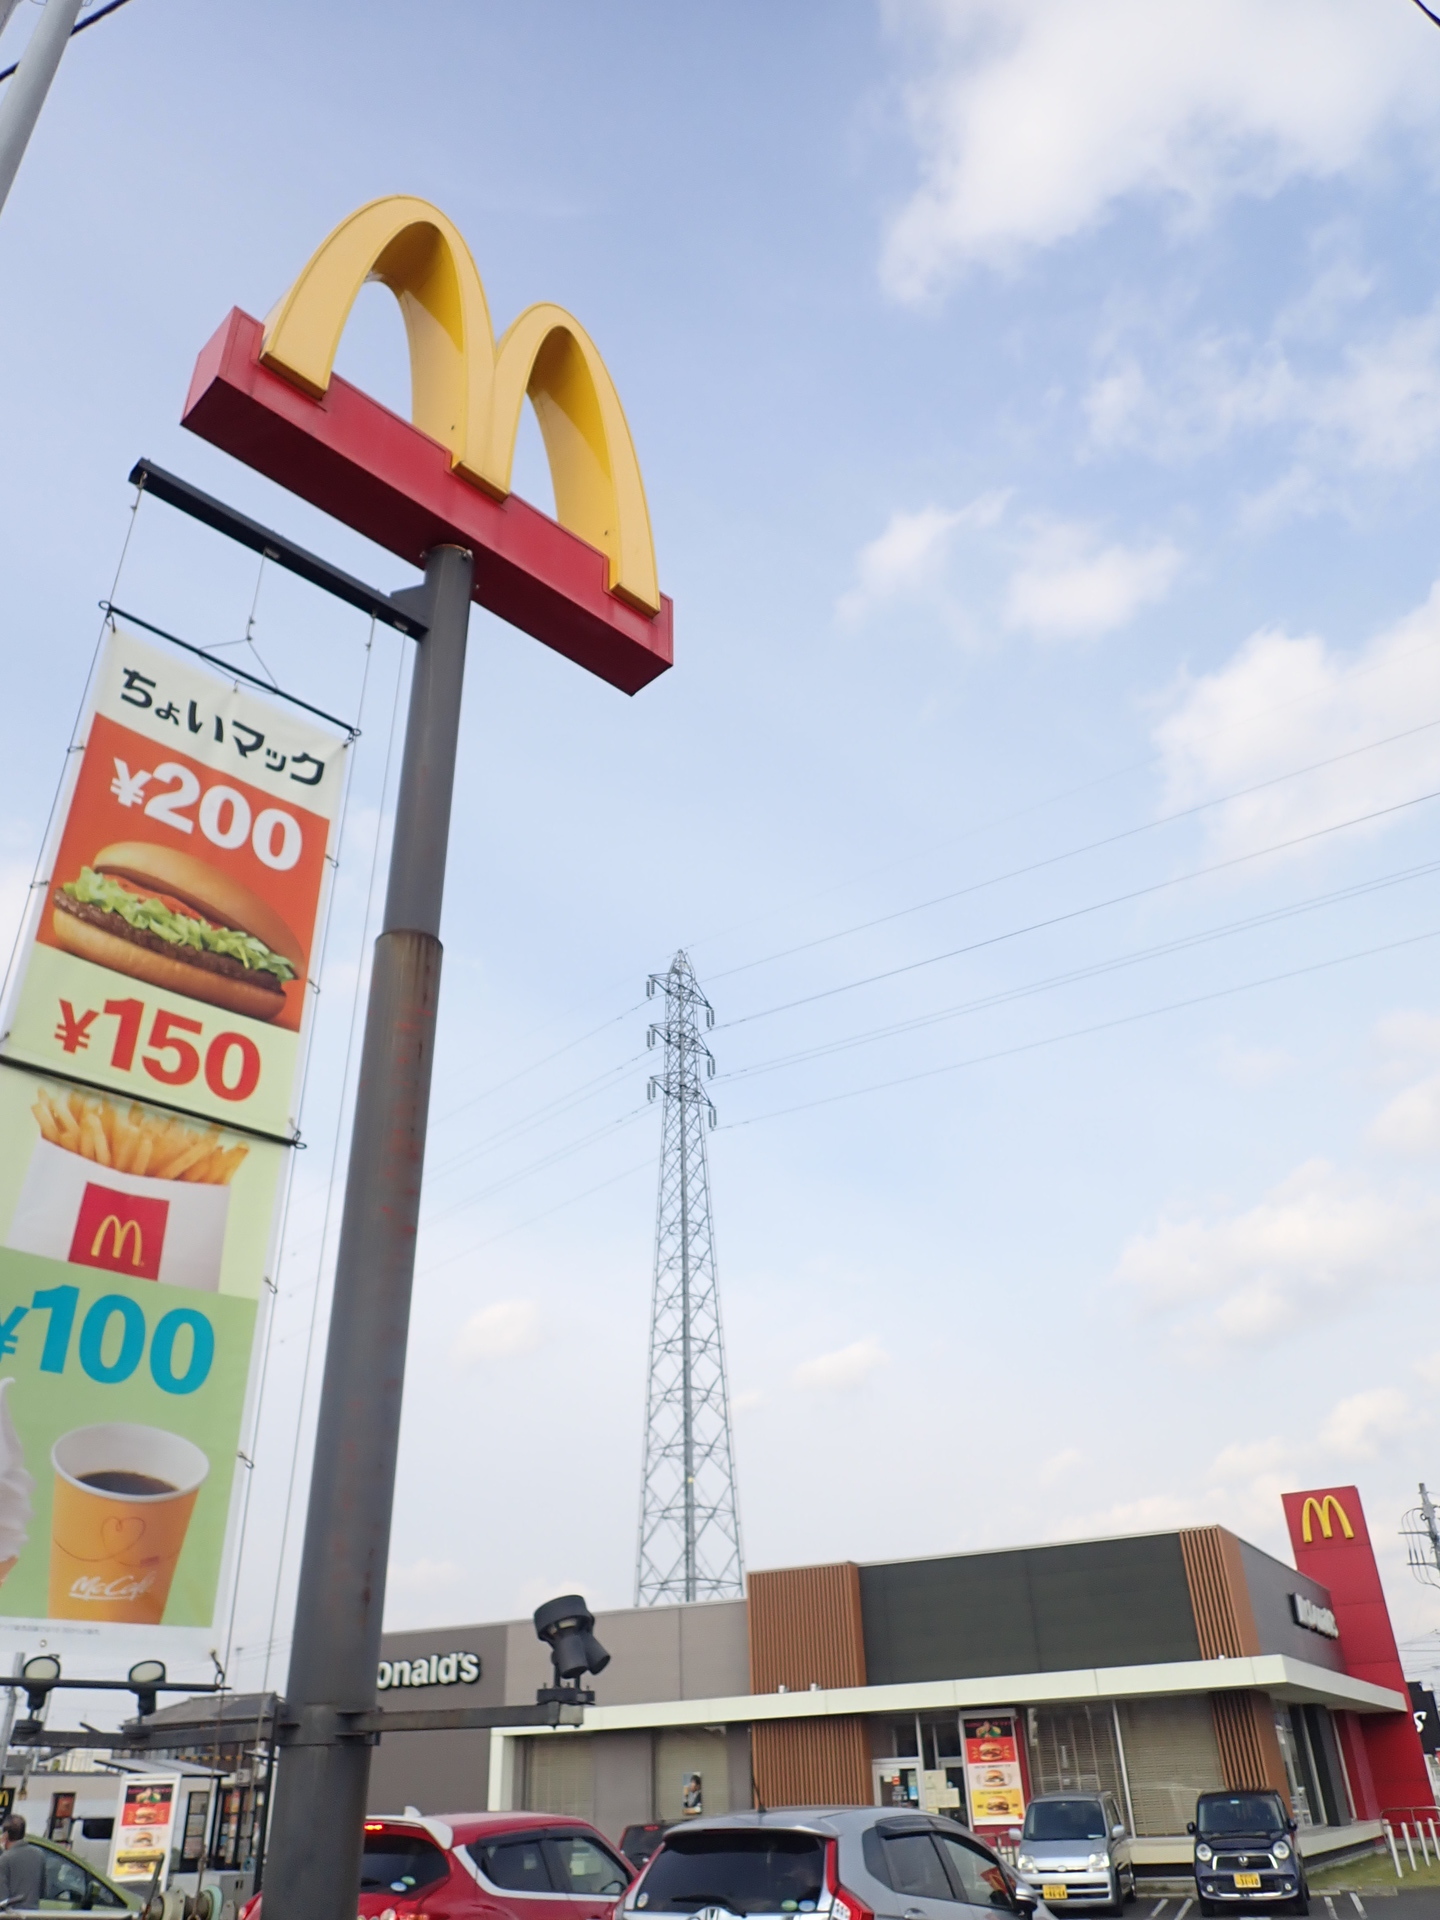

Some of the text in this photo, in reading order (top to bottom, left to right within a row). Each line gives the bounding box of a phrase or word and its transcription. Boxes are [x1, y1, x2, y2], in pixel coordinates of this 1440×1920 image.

[119, 666, 325, 786] ちょいマック
[110, 756, 302, 872] ¥200
[54, 996, 261, 1103] ¥150
[1302, 1494, 1355, 1543] M
